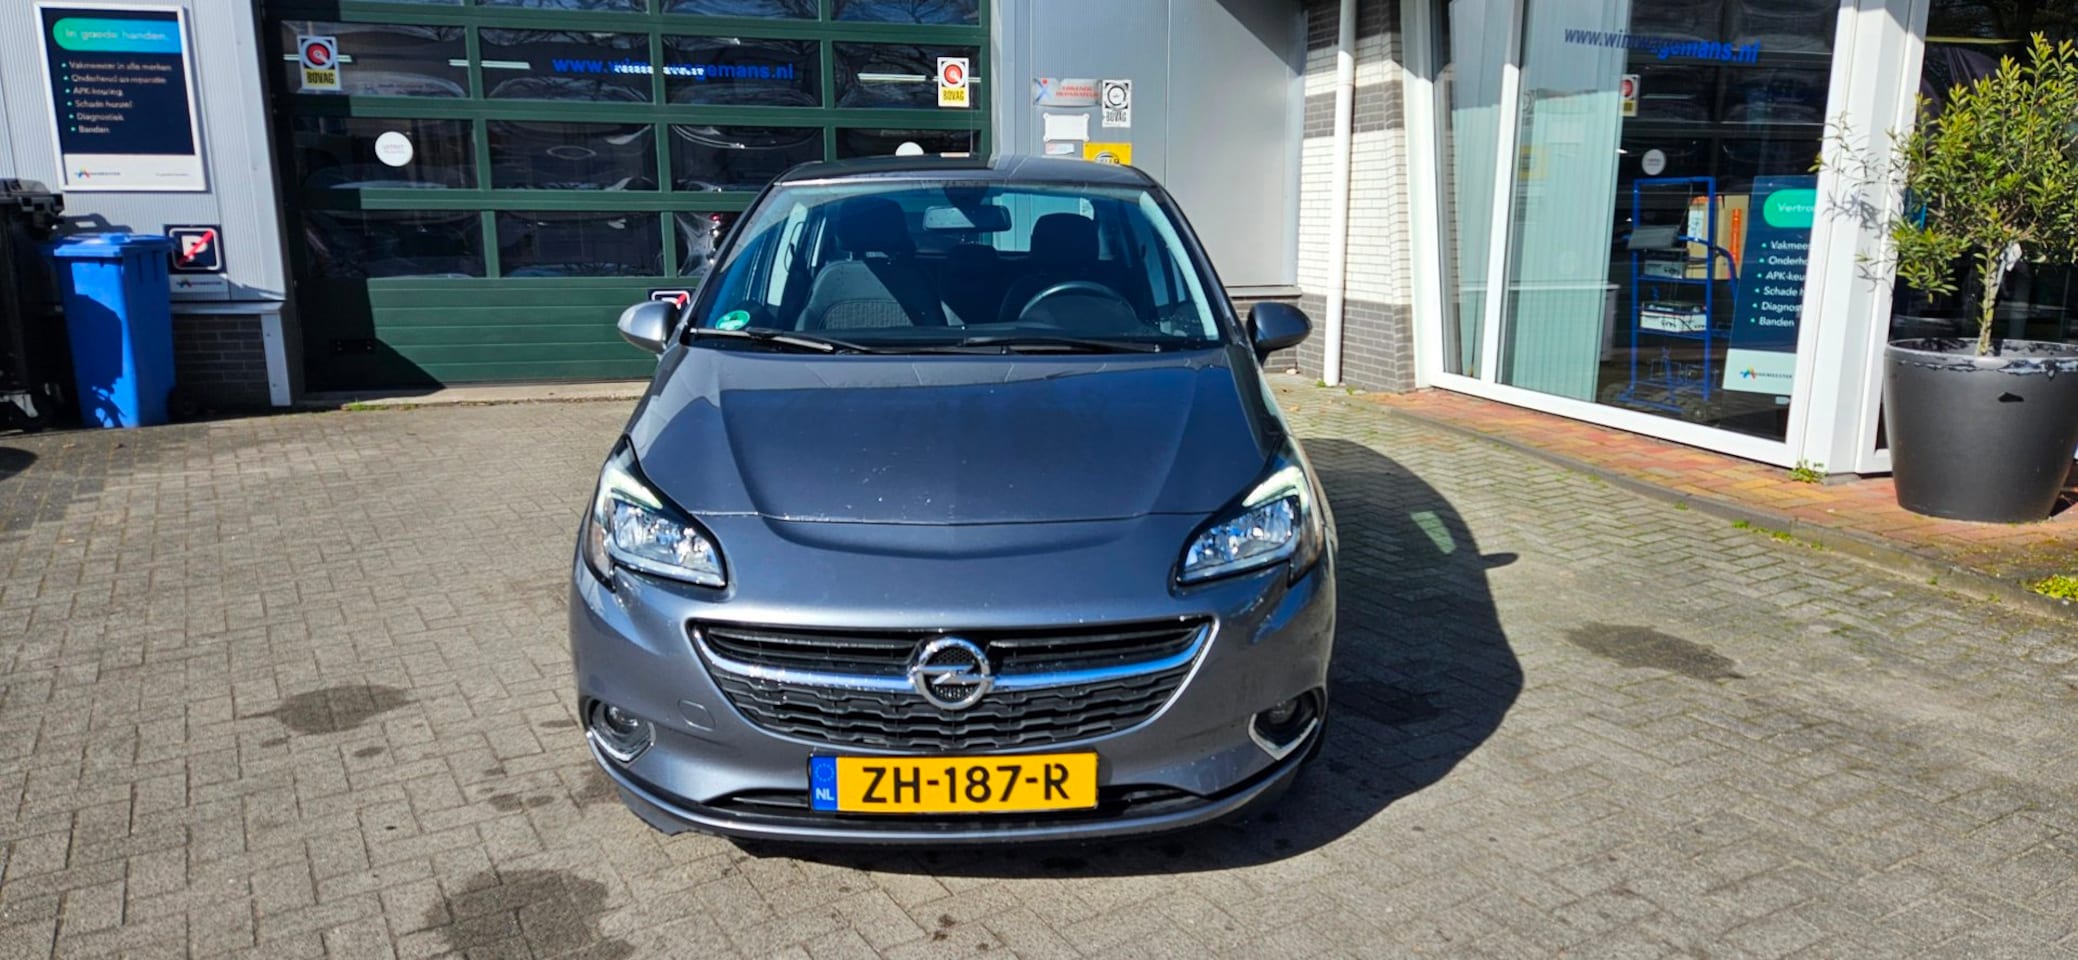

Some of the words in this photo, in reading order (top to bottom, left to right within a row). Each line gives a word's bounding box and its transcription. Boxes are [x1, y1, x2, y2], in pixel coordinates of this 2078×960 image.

[307, 71, 334, 84] BOVAG
[1771, 240, 1810, 250] Vakmee
[1765, 270, 1807, 281] APK-keu
[1763, 286, 1798, 297] Schade
[1759, 316, 1795, 327] Banden
[861, 763, 1070, 804] ZH-187-R
[815, 787, 835, 801] NL
